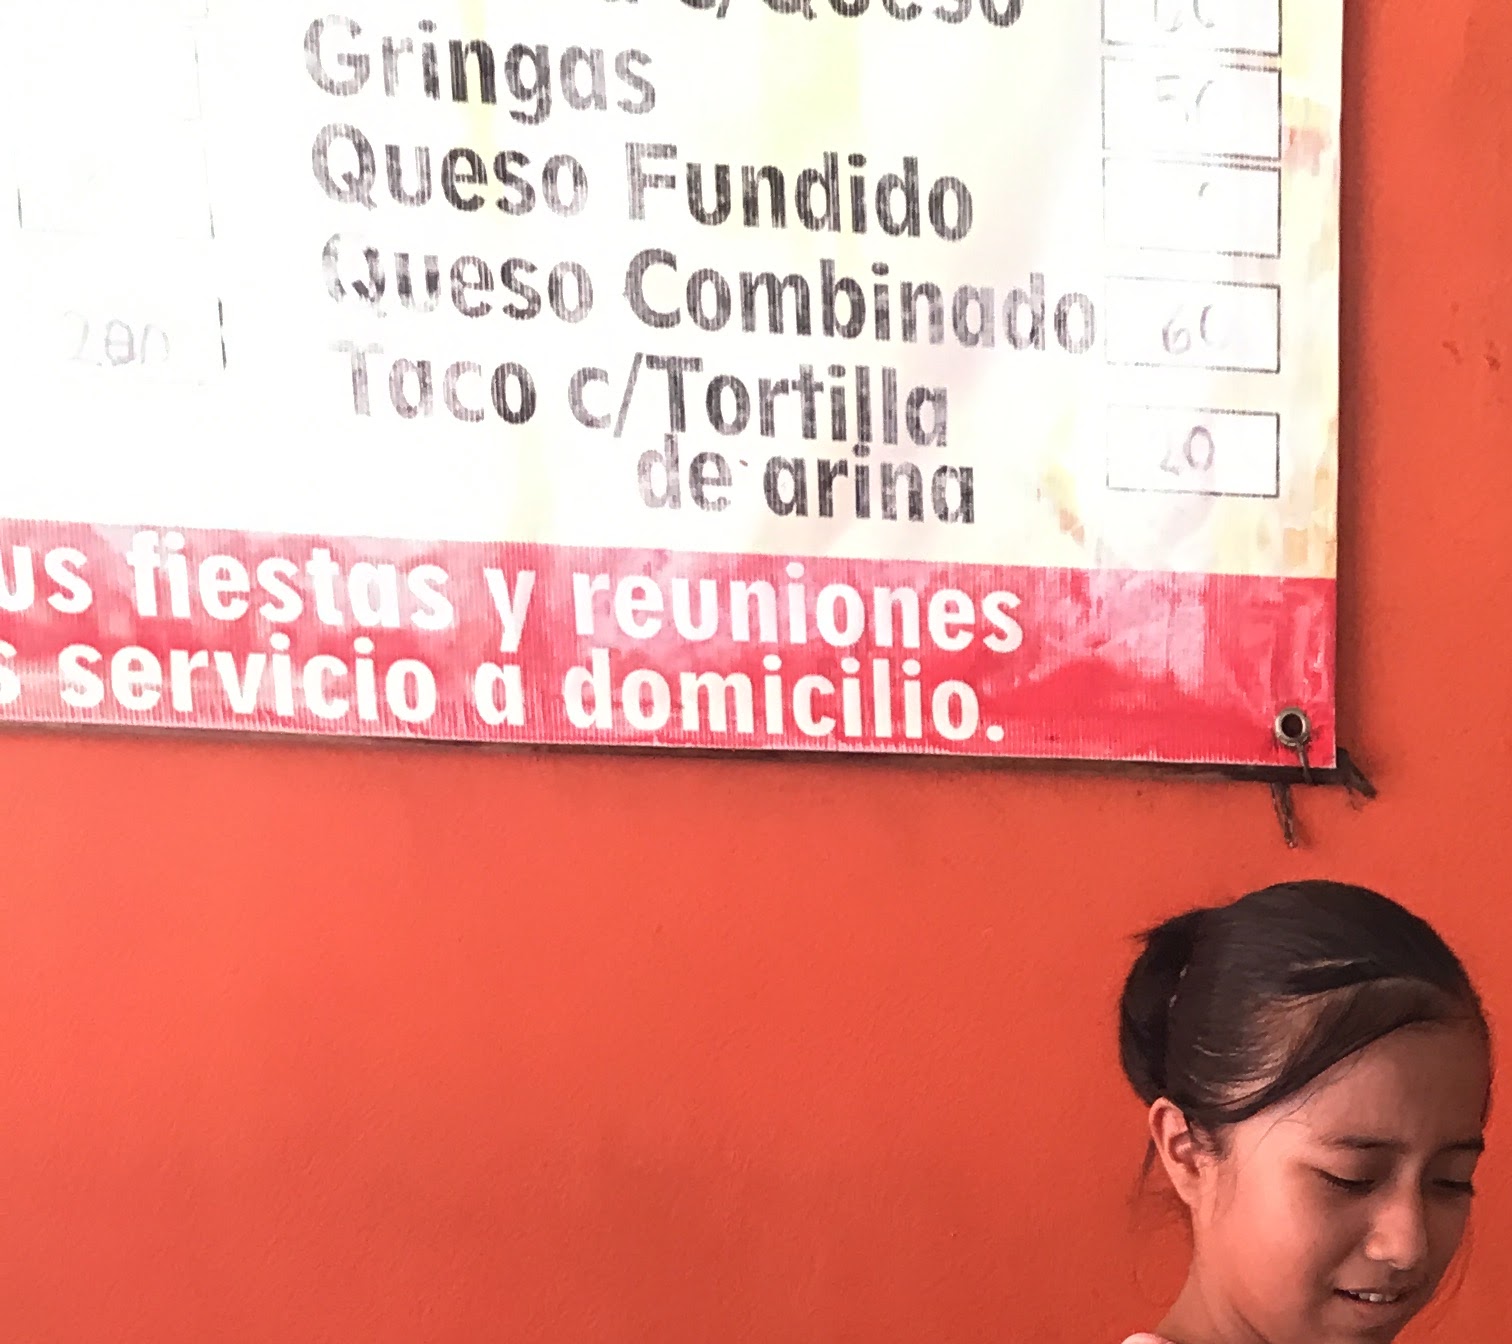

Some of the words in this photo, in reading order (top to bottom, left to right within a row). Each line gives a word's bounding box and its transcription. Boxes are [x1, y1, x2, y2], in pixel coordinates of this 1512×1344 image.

[302, 13, 657, 126] Gringas
[311, 122, 590, 216] Queso
[624, 140, 974, 243] Fundido
[320, 232, 594, 322] Queso
[624, 247, 1098, 354] Combinado
[328, 338, 537, 425] Taco
[567, 350, 949, 448] c/Tortilla
[636, 432, 733, 511] de
[762, 443, 975, 524] arina
[126, 530, 455, 632] fiestas
[484, 566, 536, 653] y
[571, 560, 1025, 654] reuniones
[57, 632, 438, 725] servicio
[472, 660, 525, 726] a
[562, 649, 1006, 742] domicilio.
